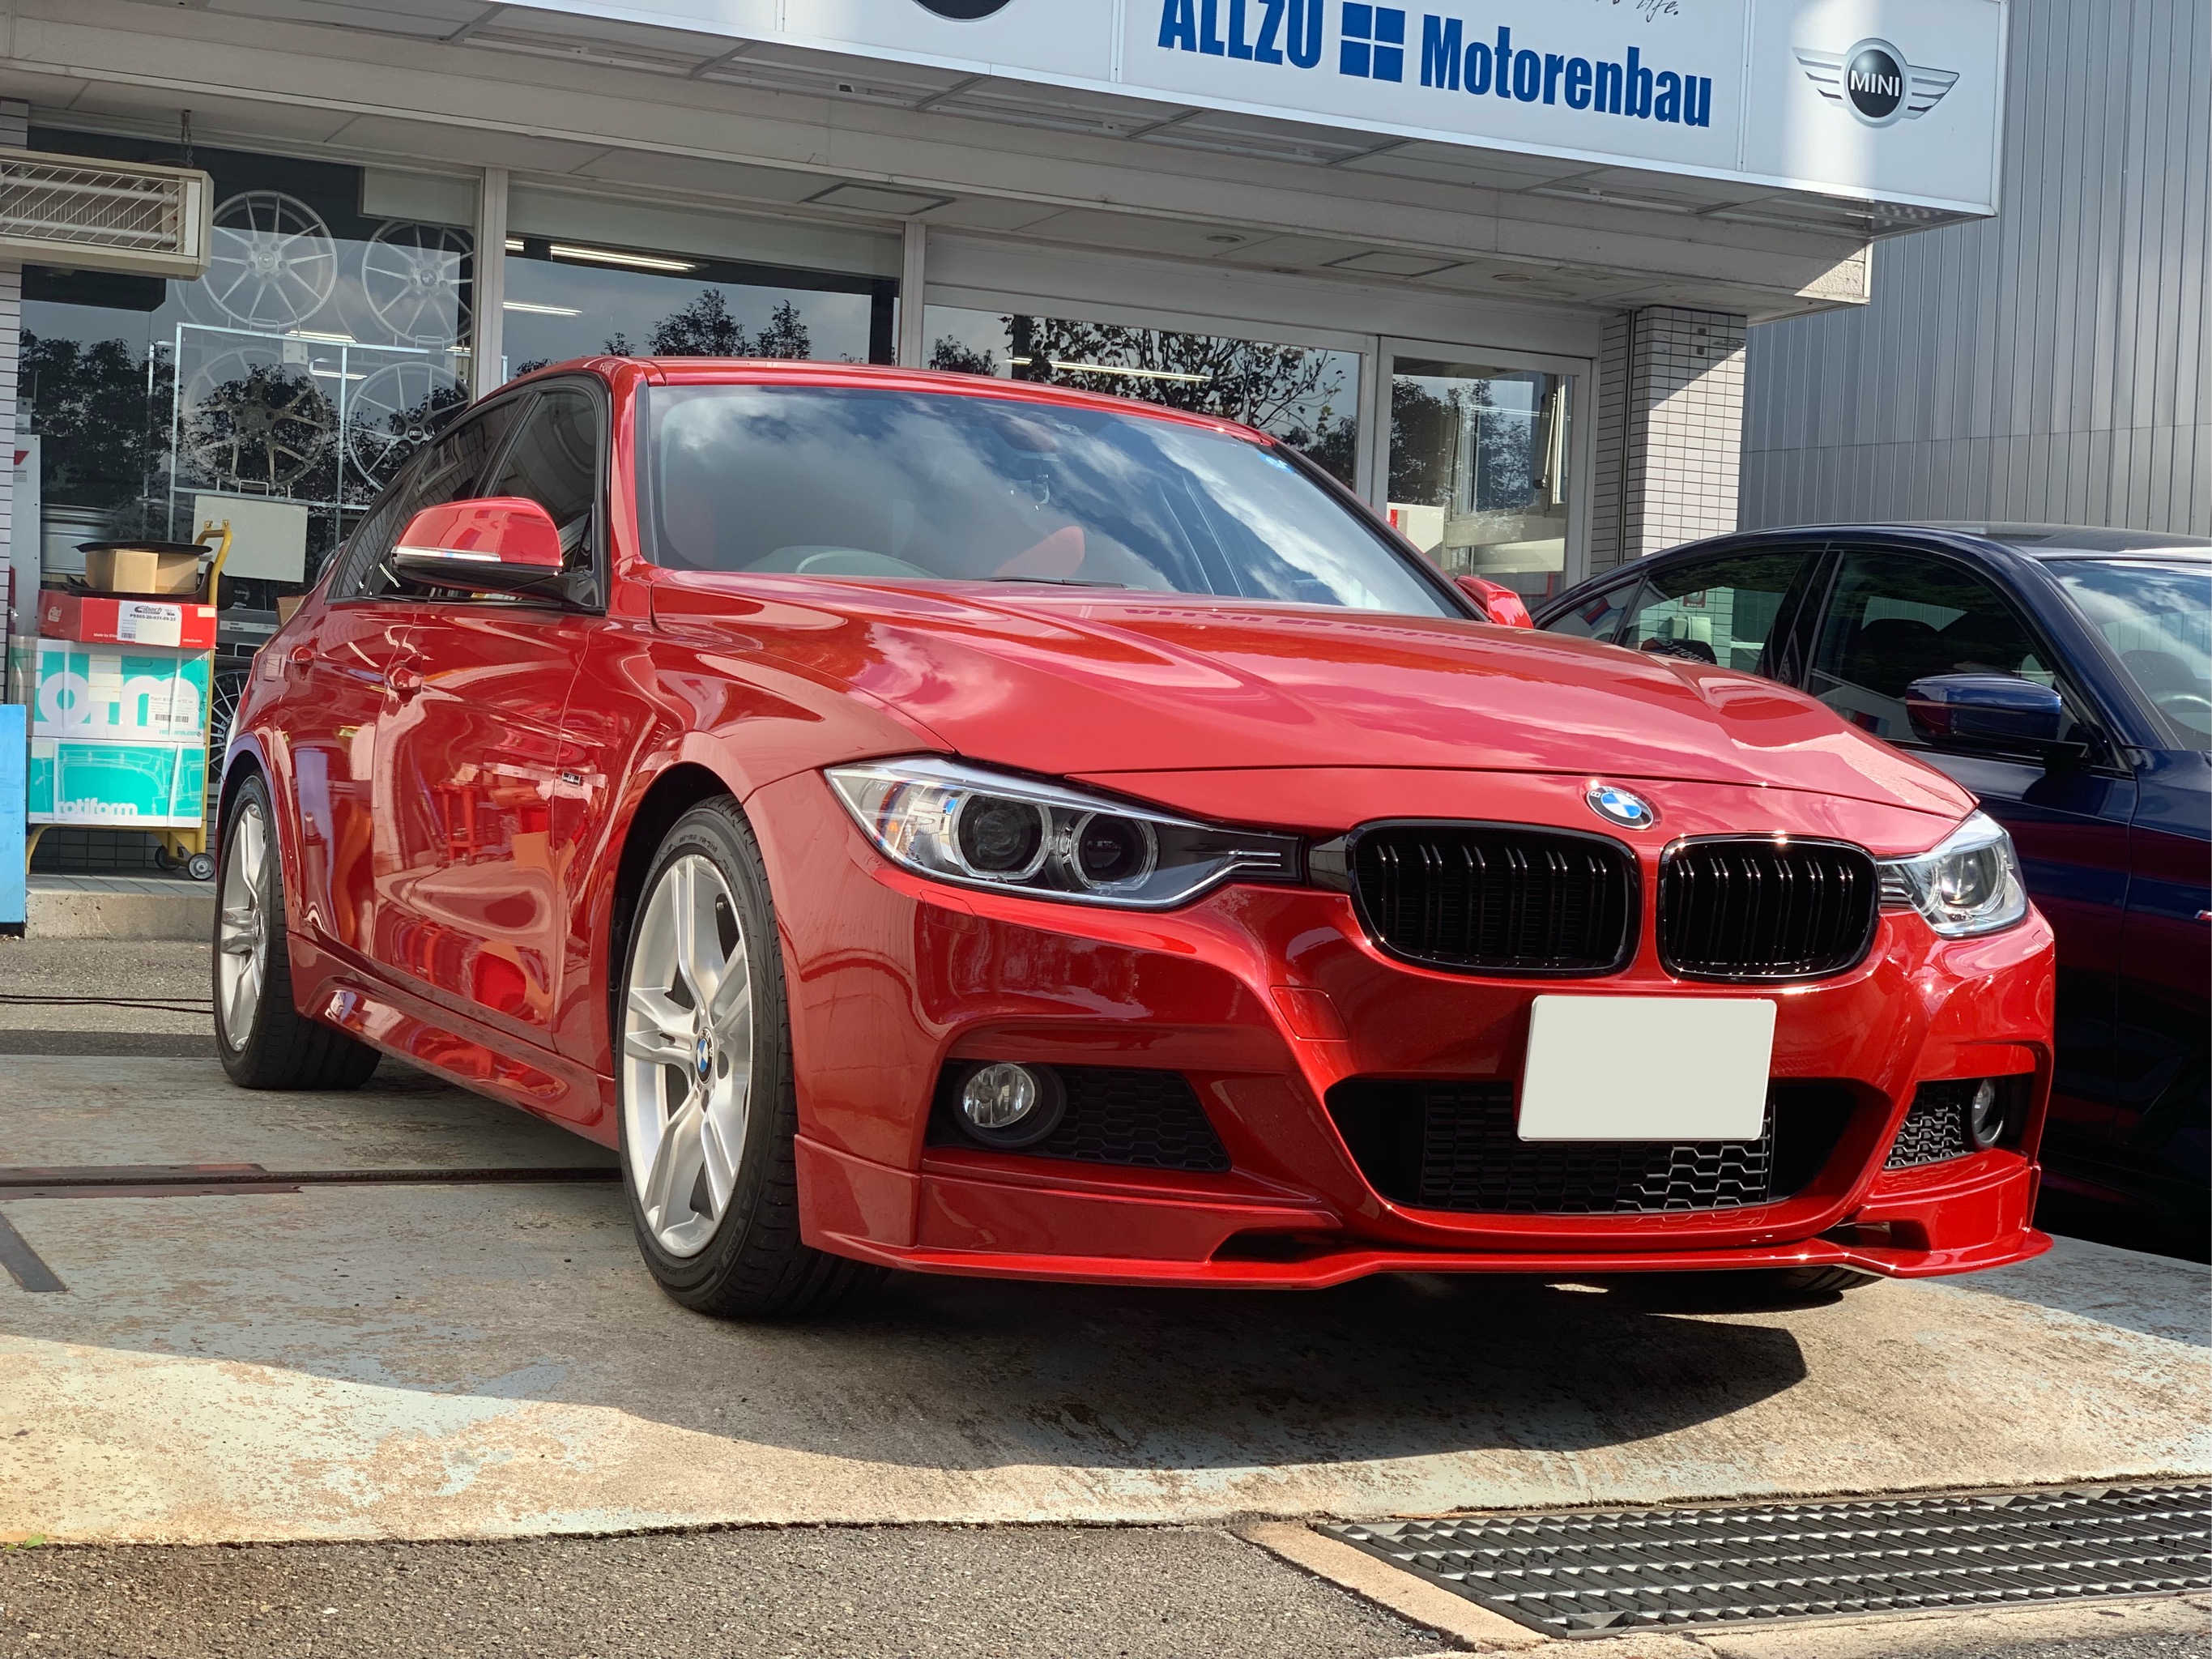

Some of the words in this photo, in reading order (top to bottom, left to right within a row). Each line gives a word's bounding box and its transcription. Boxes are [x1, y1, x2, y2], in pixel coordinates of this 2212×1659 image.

[1157, 0, 1323, 69] ALLZU
[1420, 14, 1712, 128] Motorenbau
[1850, 70, 1900, 97] MINI
[58, 797, 139, 816] rotiform
